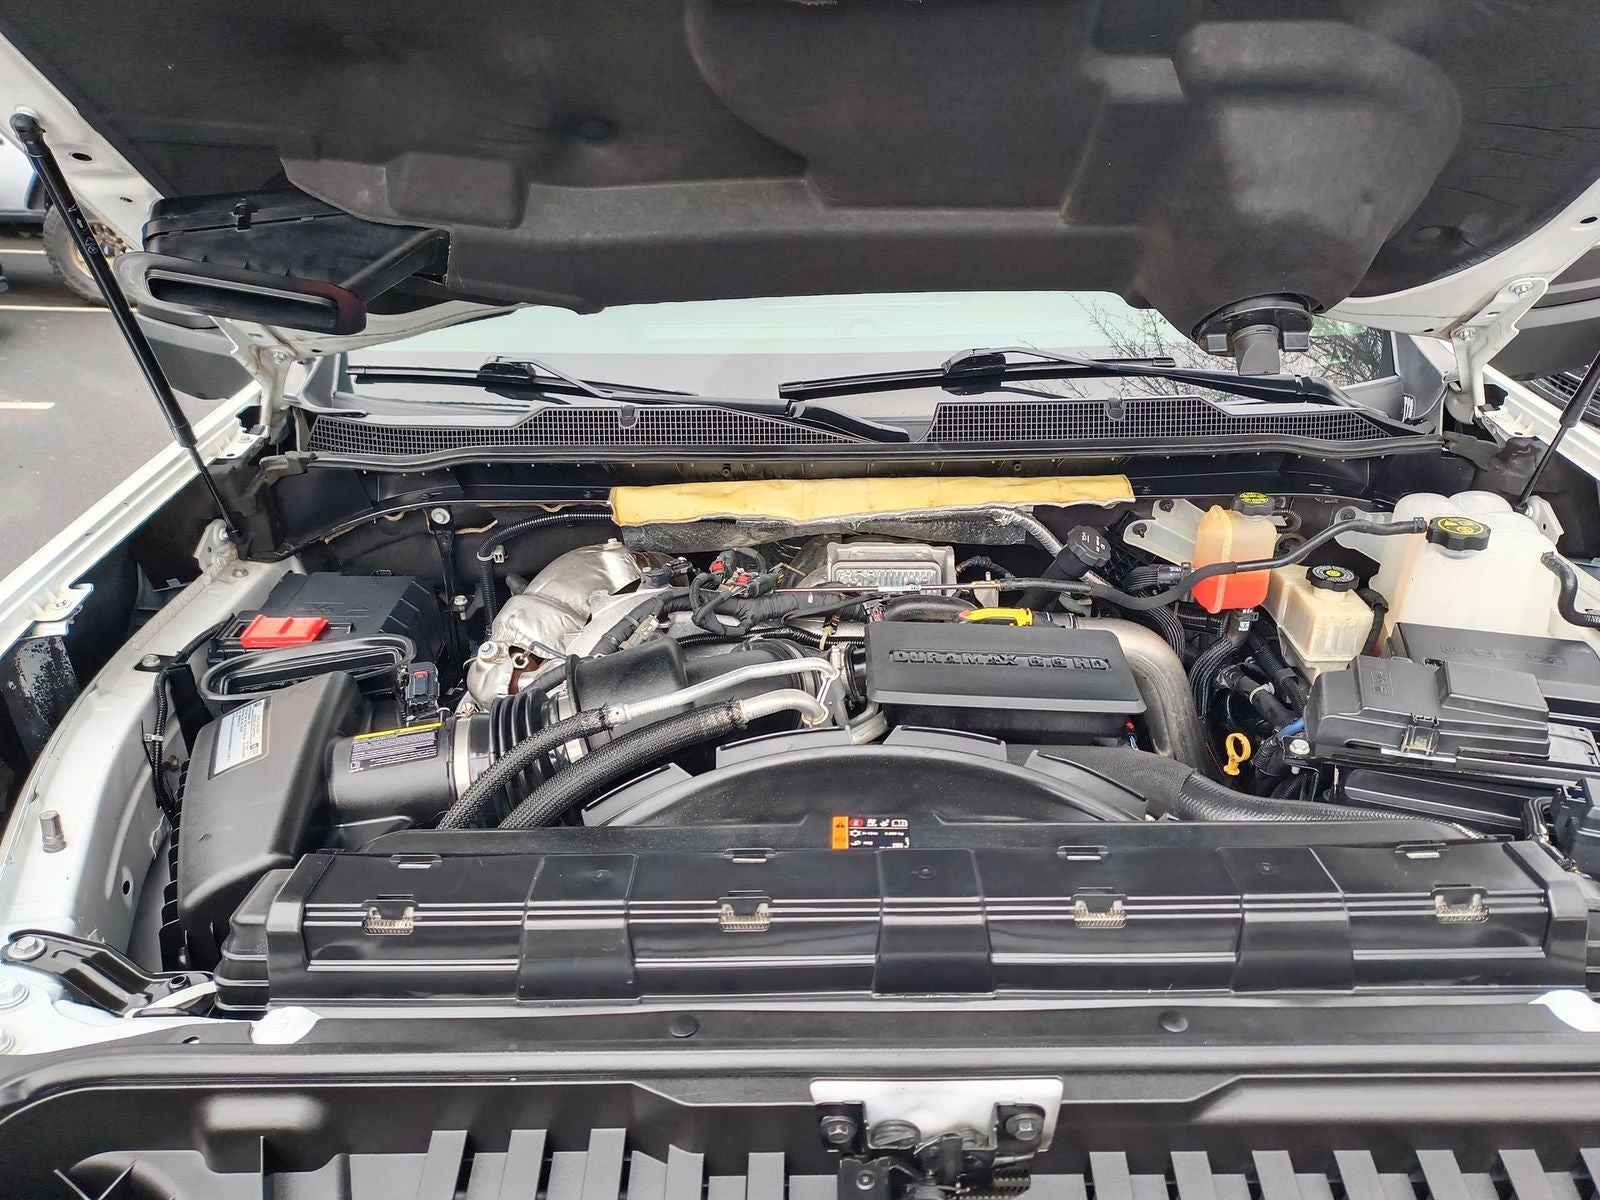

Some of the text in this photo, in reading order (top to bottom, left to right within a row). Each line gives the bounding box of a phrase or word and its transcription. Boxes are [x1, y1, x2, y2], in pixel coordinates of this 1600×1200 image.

[892, 650, 1110, 671] DURAMAX 6.6 HD
